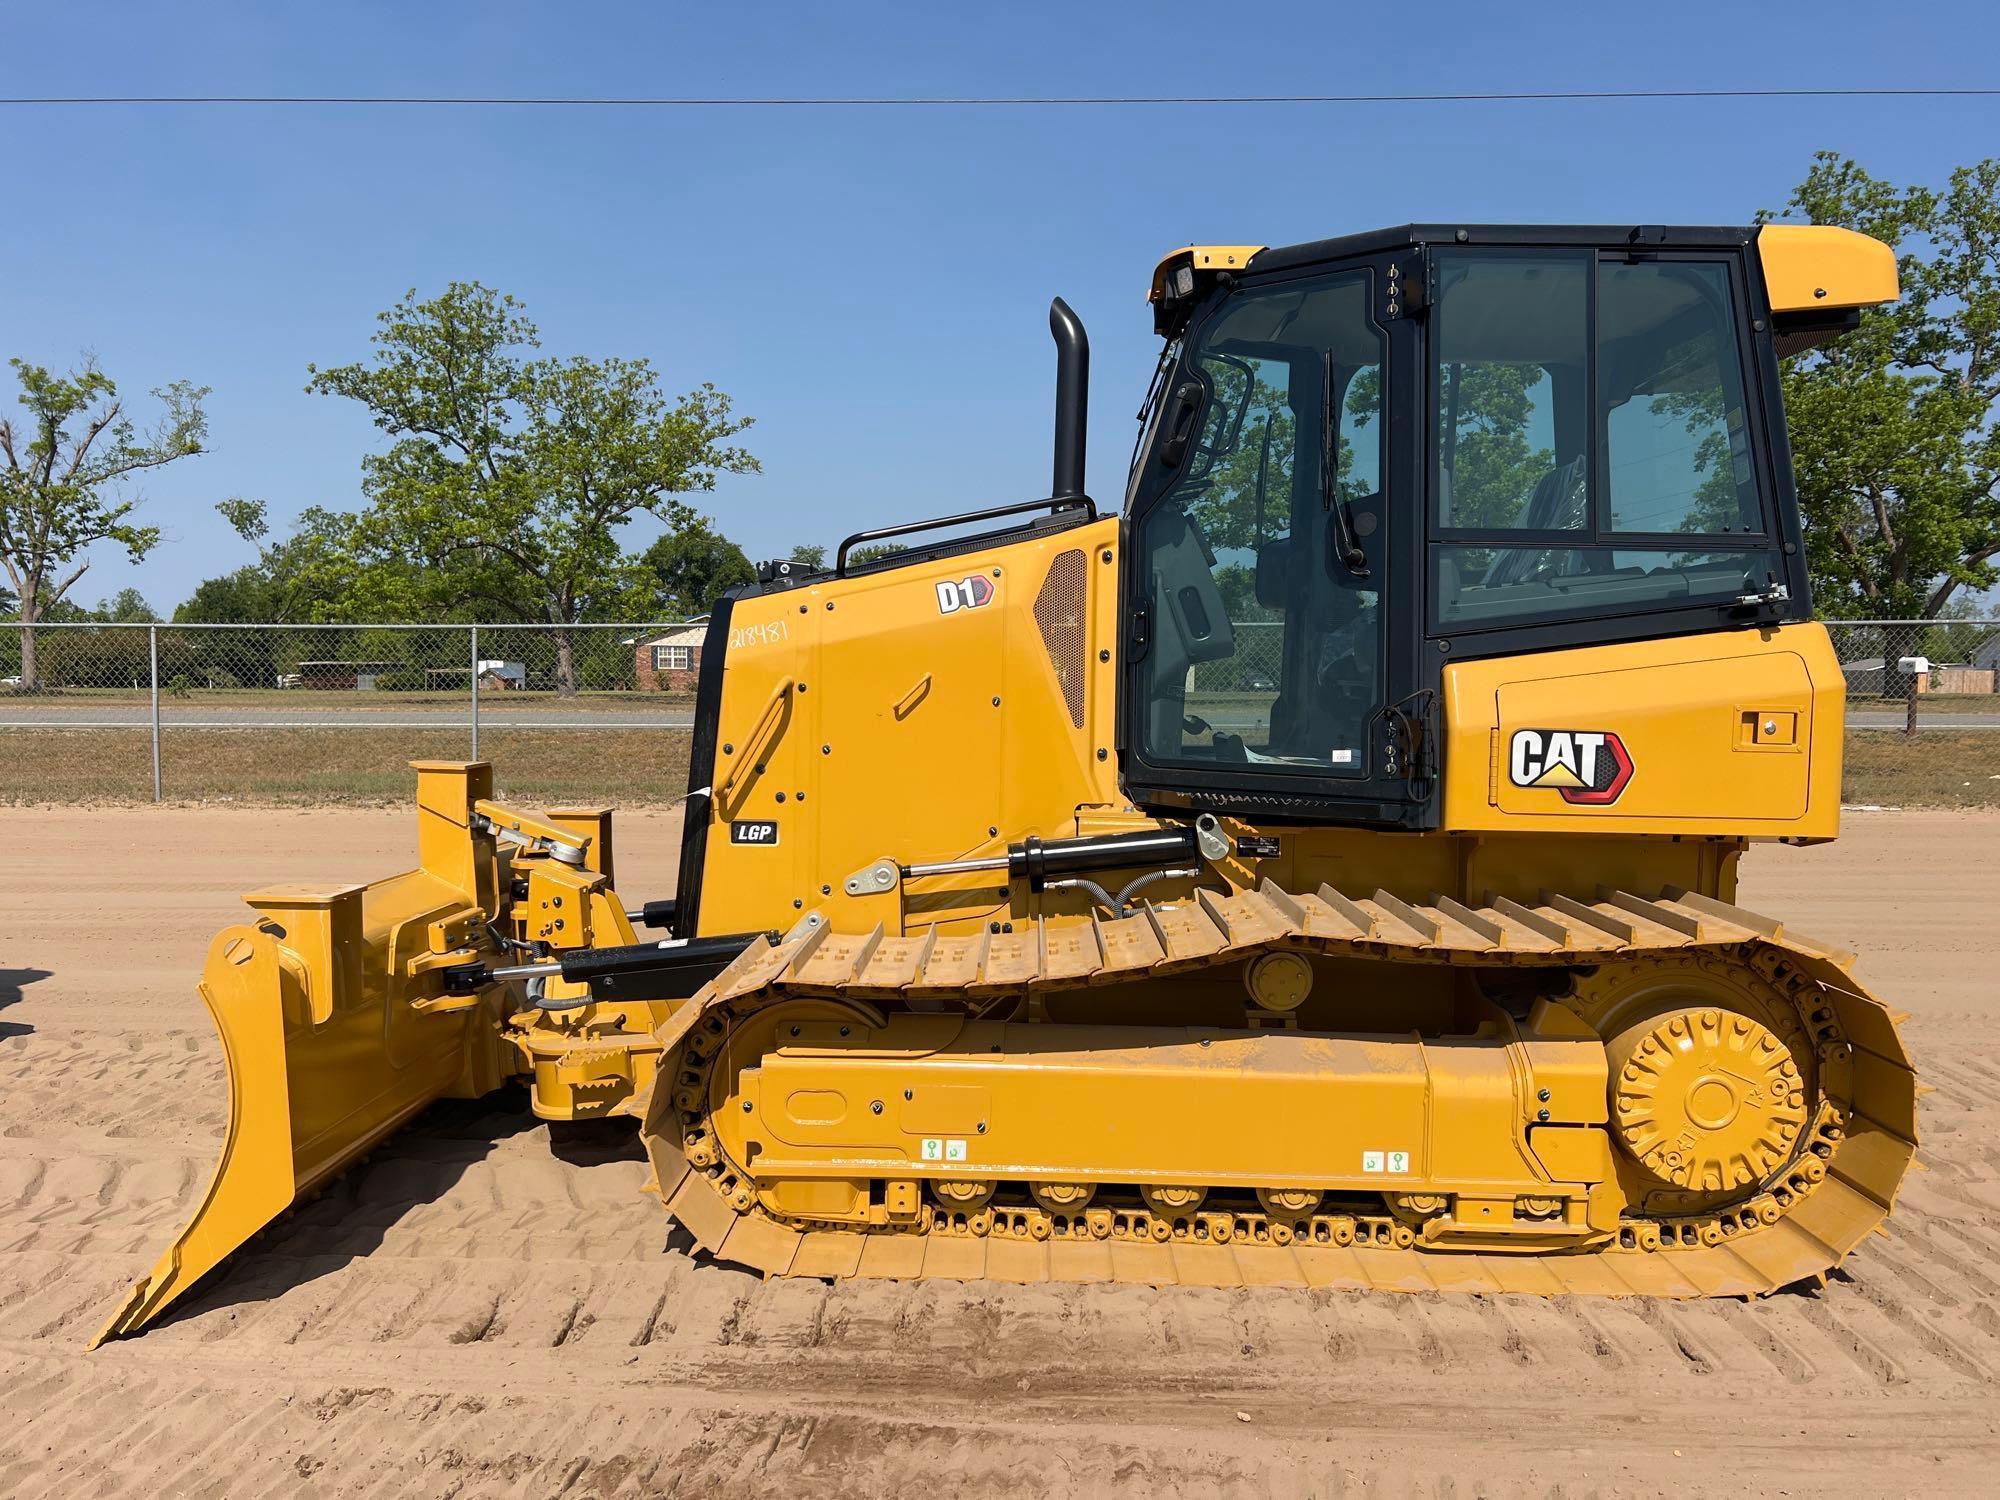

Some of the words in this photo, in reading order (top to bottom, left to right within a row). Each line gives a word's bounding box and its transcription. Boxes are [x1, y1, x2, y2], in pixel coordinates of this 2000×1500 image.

[936, 577, 976, 613] D1
[730, 620, 788, 650] 218481
[1511, 730, 1605, 788] CAT
[738, 824, 772, 841] LGP
